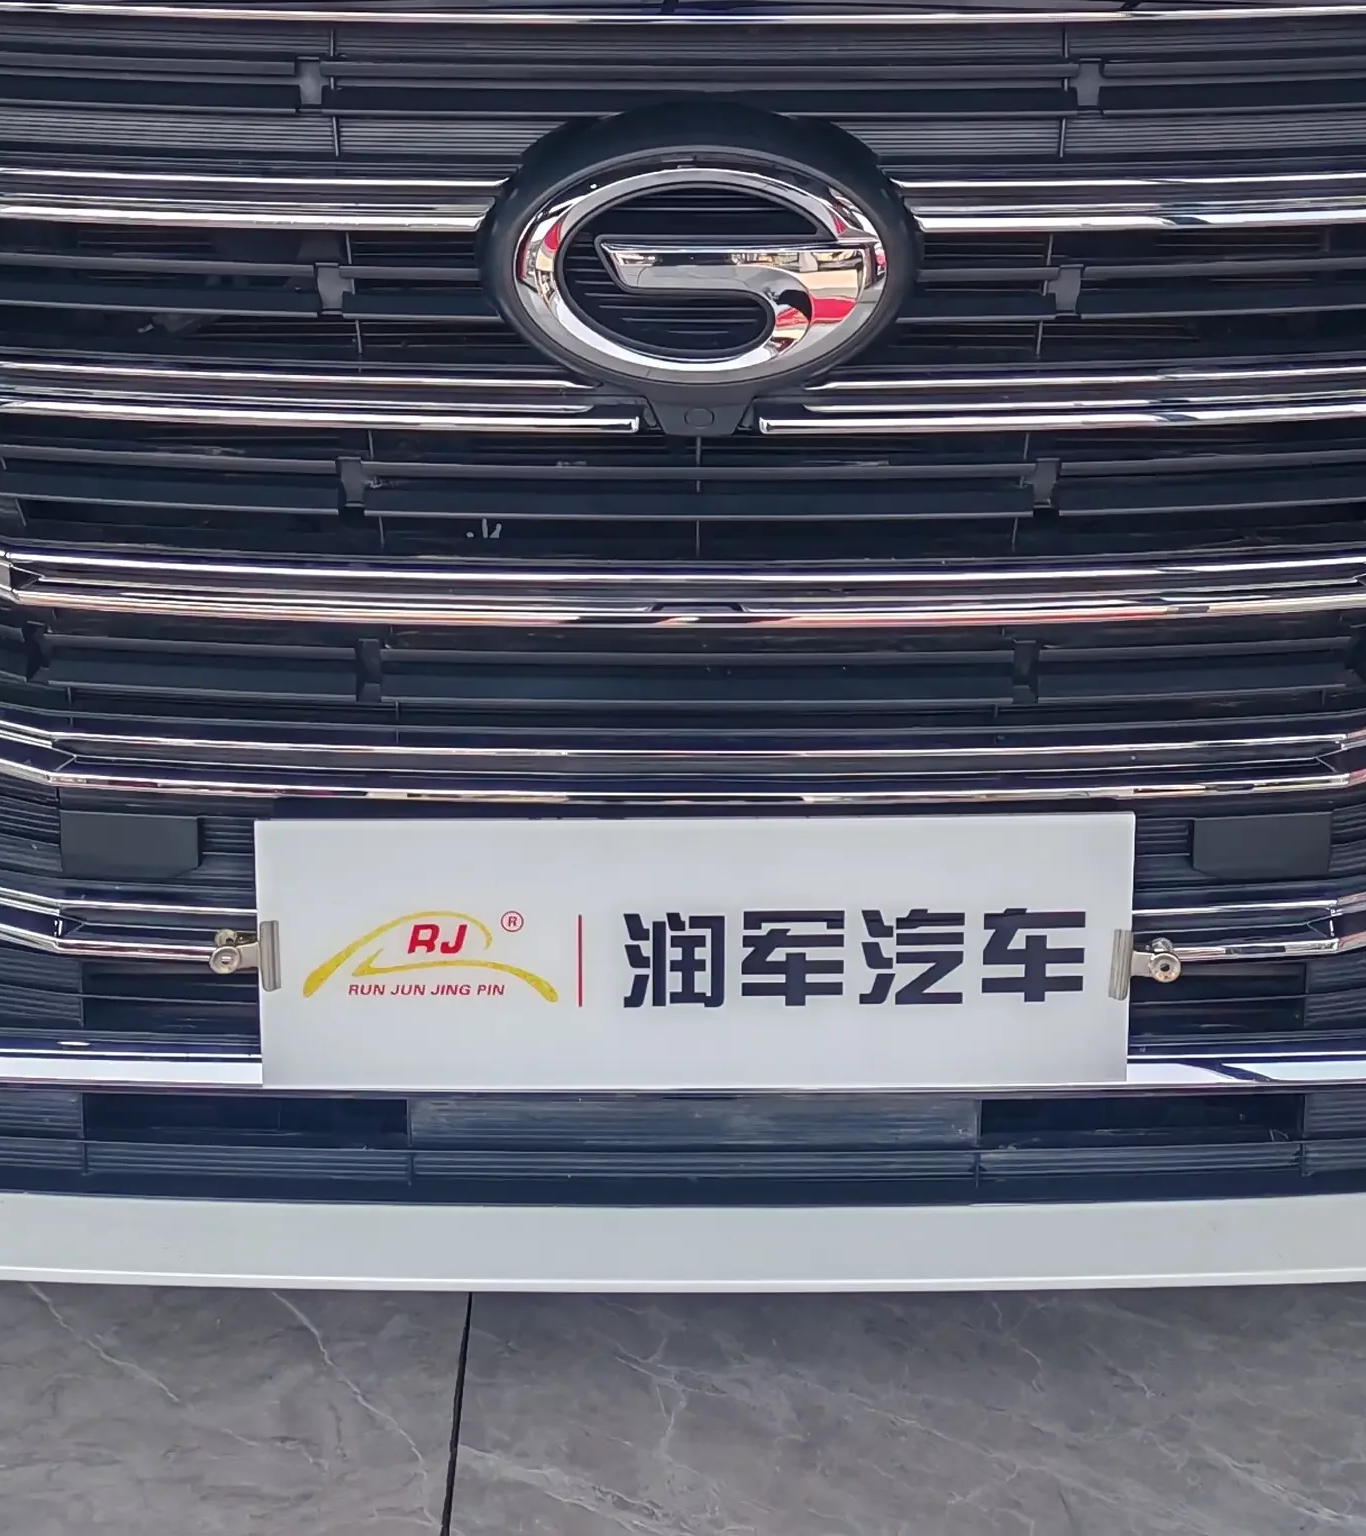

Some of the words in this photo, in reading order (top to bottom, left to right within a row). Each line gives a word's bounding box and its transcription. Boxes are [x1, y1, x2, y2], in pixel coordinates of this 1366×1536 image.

[406, 923, 468, 955] RJ
[622, 907, 1087, 1008] 润军汽车
[348, 984, 385, 996] RUN
[390, 984, 426, 996] JUN
[430, 984, 471, 996] JING
[477, 984, 505, 996] PIN
